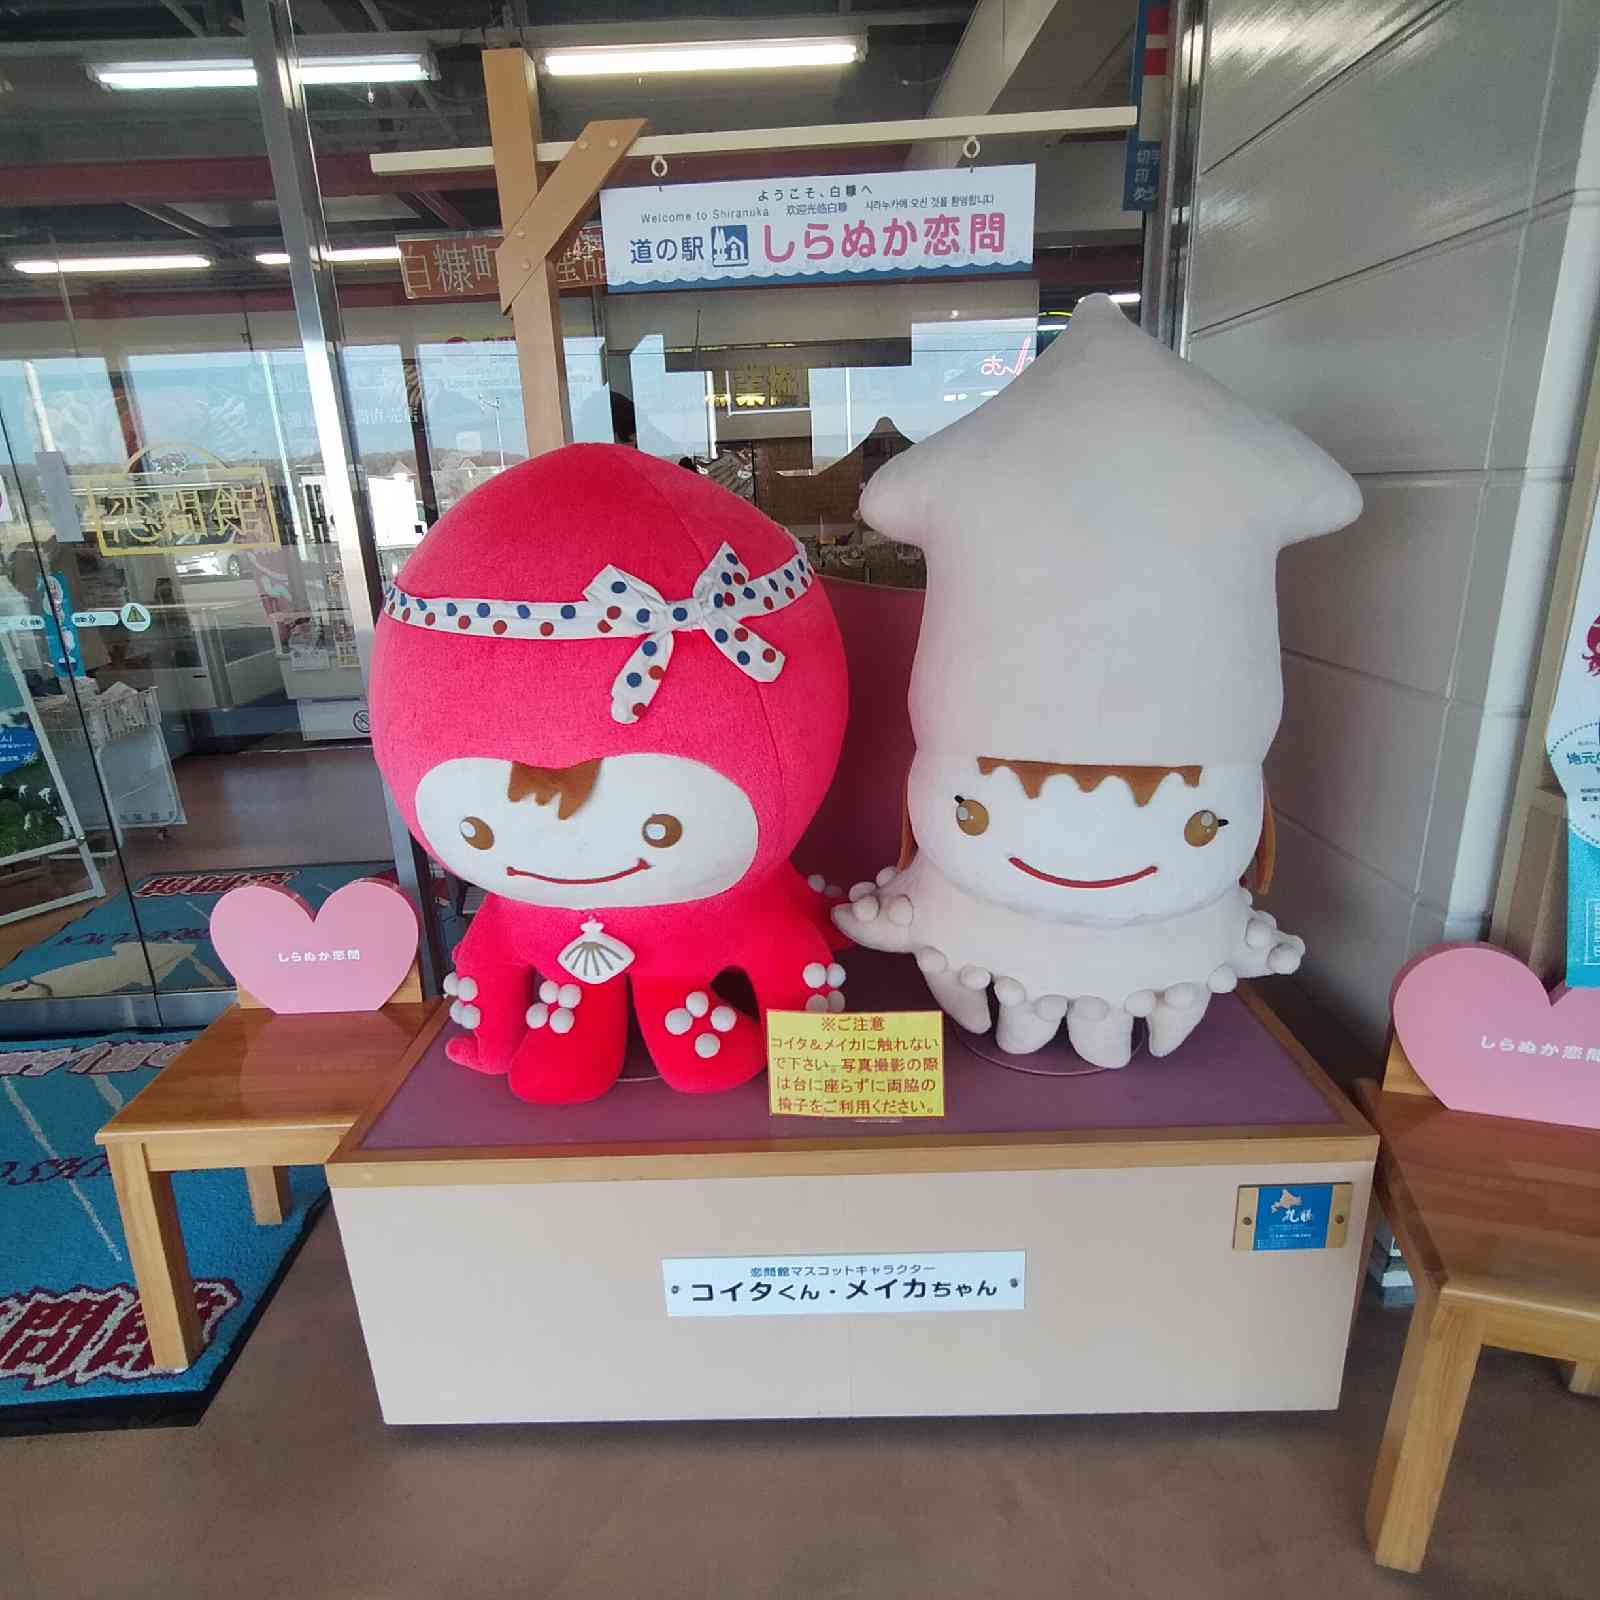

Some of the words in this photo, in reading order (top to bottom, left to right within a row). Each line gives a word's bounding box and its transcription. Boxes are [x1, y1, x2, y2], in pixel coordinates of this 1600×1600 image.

[641, 212, 692, 224] Welcome
[696, 211, 708, 221] to
[712, 206, 770, 219] Shiranuka
[763, 212, 1006, 262] しらぬか恋問
[630, 236, 705, 264] 道の駅
[278, 949, 361, 962] しらぬか恋問
[692, 1278, 998, 1302] コイタくん・メイカちゃん
